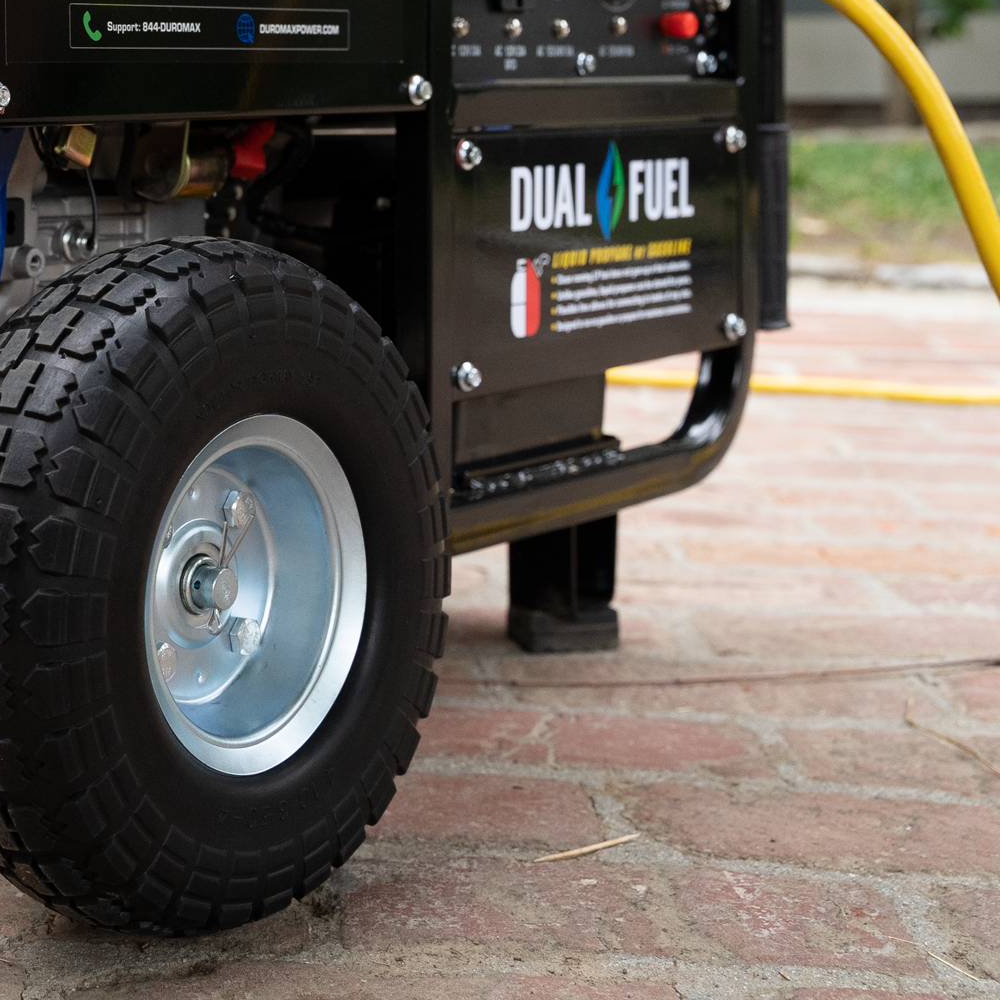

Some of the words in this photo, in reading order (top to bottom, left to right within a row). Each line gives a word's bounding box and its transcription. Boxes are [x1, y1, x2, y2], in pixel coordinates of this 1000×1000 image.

[107, 21, 141, 35] Support:
[143, 22, 201, 33] 844-DUROMAX
[260, 24, 339, 35] DUROMAXPOWER.COM
[511, 163, 592, 232] DUAL
[628, 158, 695, 222] FUEL
